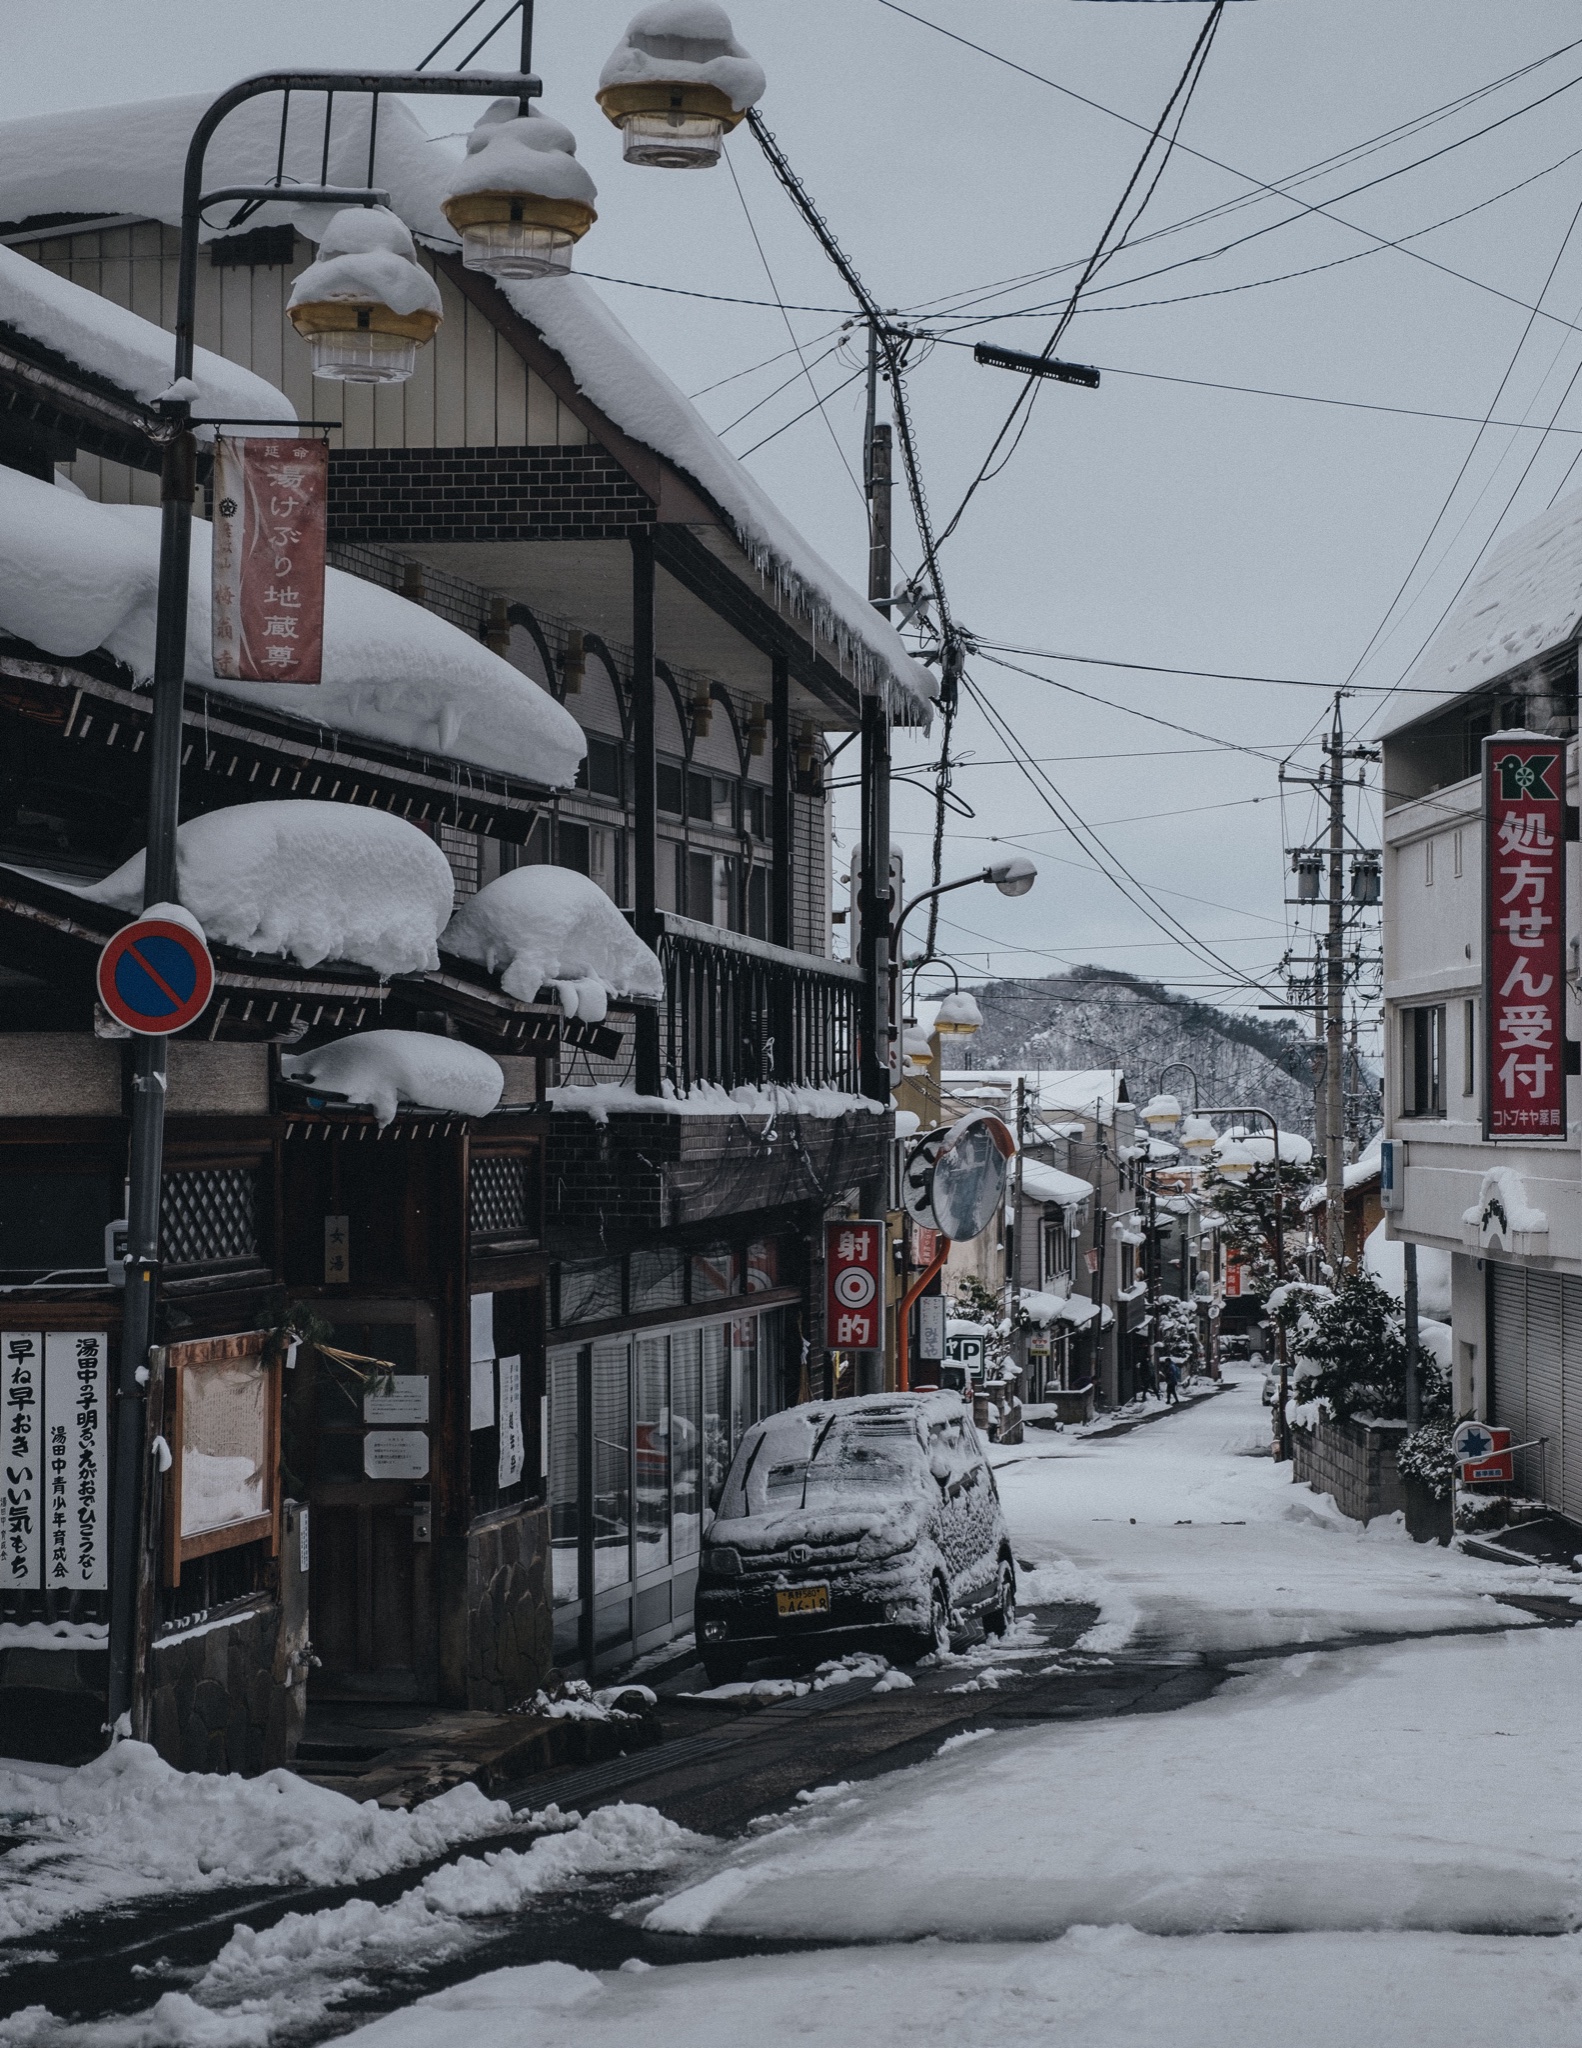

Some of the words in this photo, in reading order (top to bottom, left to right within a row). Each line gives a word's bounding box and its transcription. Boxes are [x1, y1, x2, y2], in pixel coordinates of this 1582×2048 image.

[263, 445, 310, 460] 延命
[260, 464, 306, 669] 湯けぶり地蔵尊
[1497, 810, 1554, 1100] 処方せん受付
[329, 1227, 344, 1272] 女湯
[963, 1342, 980, 1361] P
[51, 1425, 69, 1579] 湯田中青少年育成会
[75, 1338, 100, 1581] 湯田中の子明るいえがおでひこうなし
